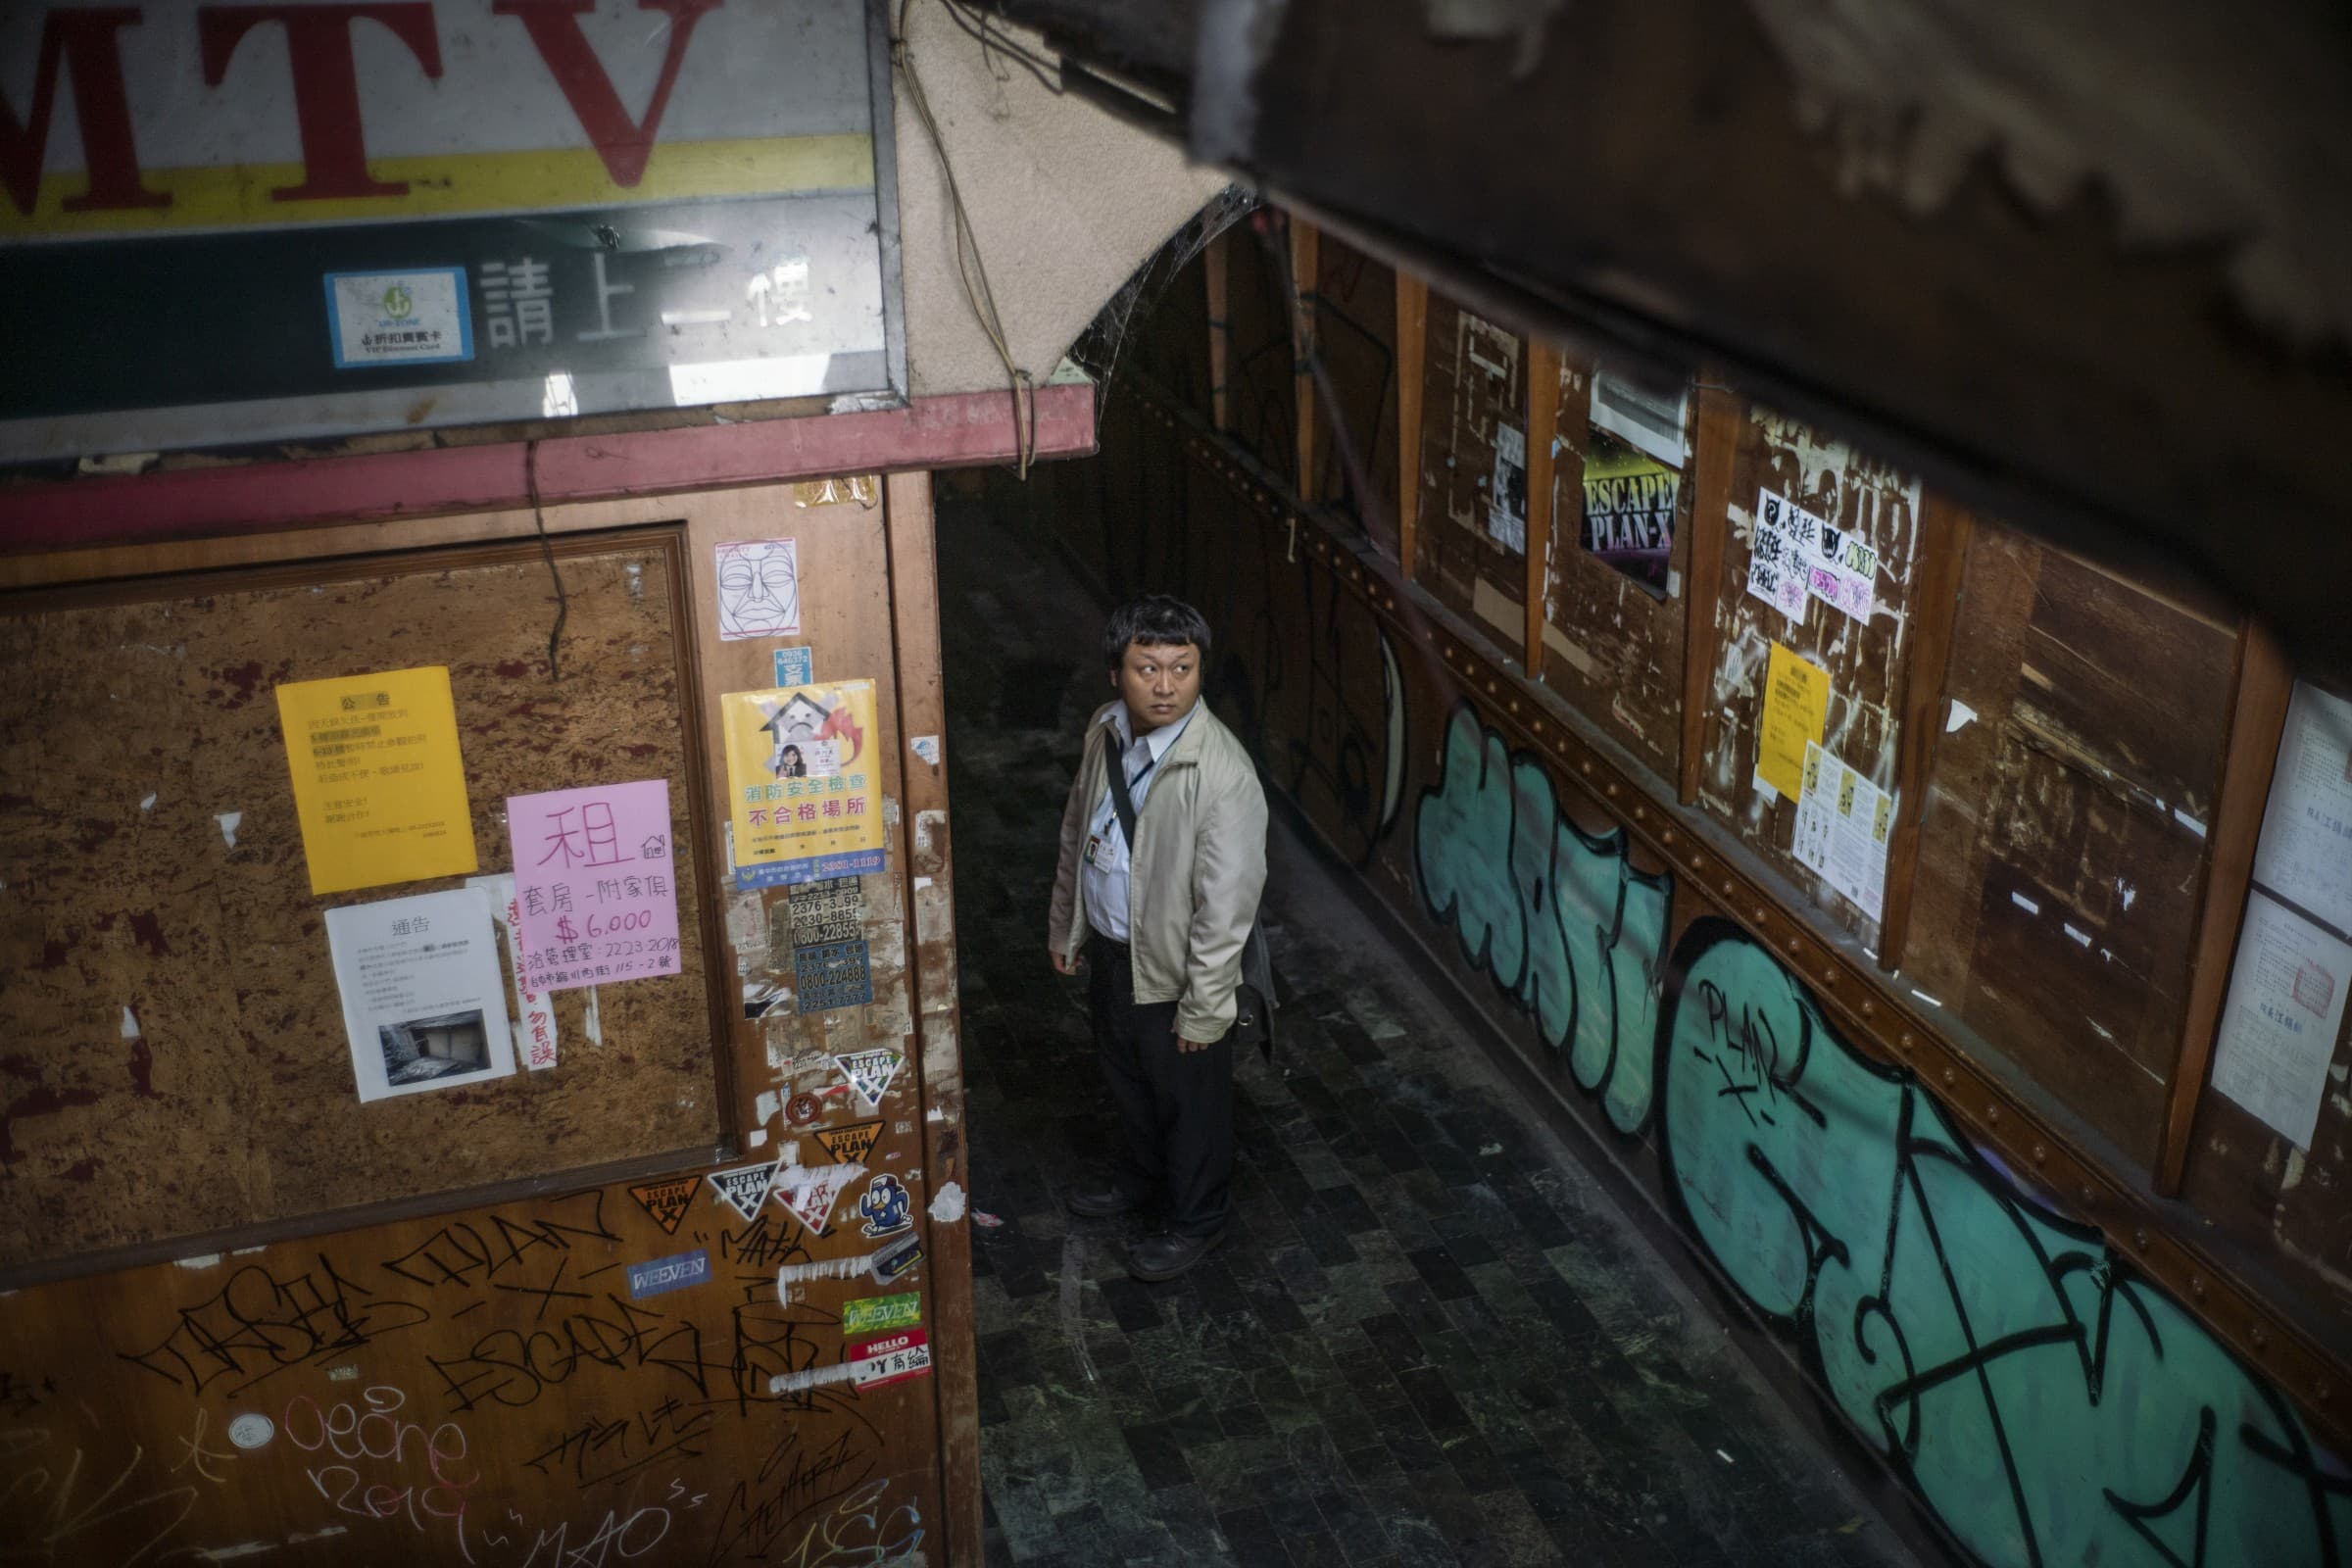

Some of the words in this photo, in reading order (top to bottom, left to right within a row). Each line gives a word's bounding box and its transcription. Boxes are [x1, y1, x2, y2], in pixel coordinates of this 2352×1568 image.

[1584, 472, 1673, 515] ESCAPE
[1590, 510, 1672, 551] PLAN-X
[744, 774, 867, 804] 消防安全檢查
[749, 797, 866, 828] 不合格場所
[537, 802, 635, 869] 租
[792, 895, 858, 915] 2376-399
[391, 915, 430, 937] 通告
[853, 1055, 893, 1069] ESCAPE
[851, 1064, 894, 1079] PLAN
[862, 1077, 884, 1095] X
[831, 1139, 873, 1153] PLAN
[832, 1130, 869, 1144] ESCAPE
[726, 1171, 765, 1187] ESCAPE
[647, 1186, 686, 1200] ESCAPE
[725, 1179, 769, 1198] PLAN
[645, 1194, 692, 1212] PLAN
[738, 1193, 760, 1210] X
[660, 1206, 680, 1224] X
[632, 1256, 707, 1291] WEEVEN
[866, 1336, 909, 1354] HELLO
